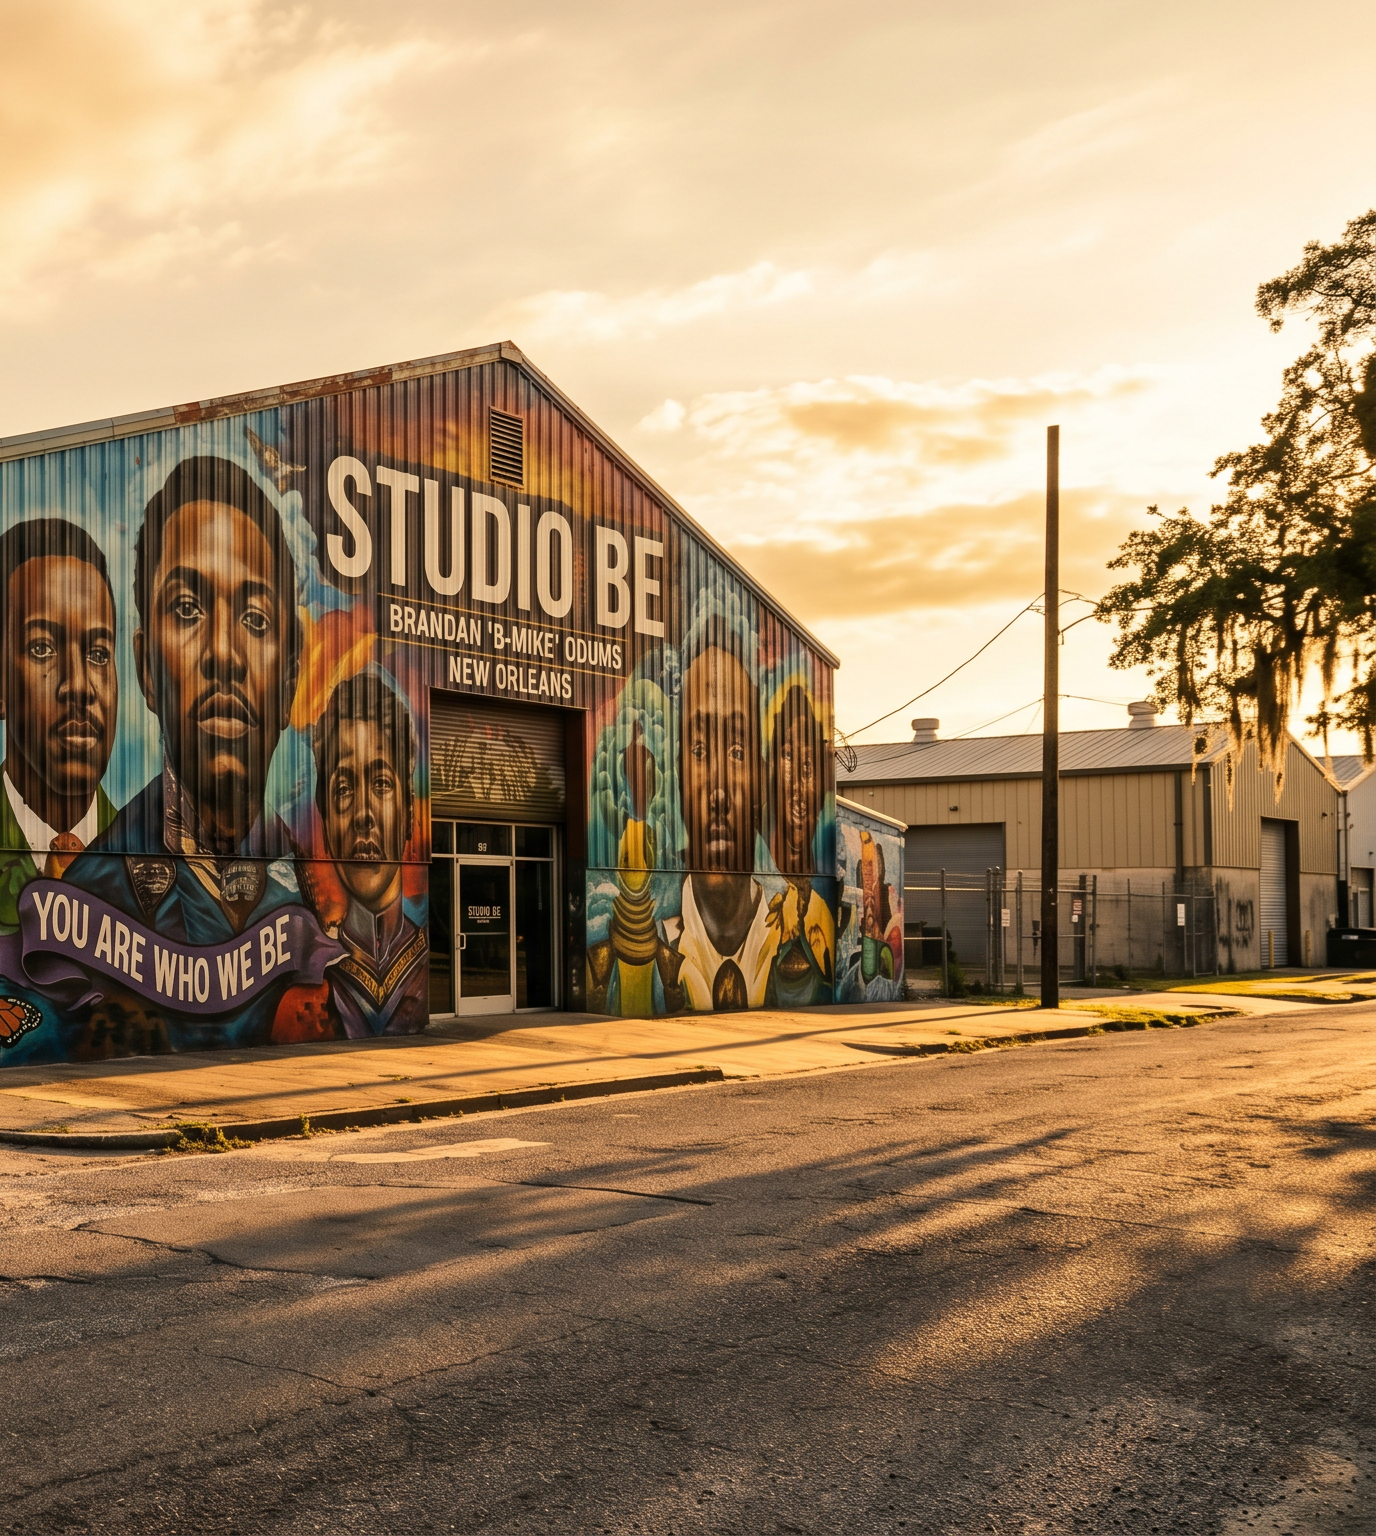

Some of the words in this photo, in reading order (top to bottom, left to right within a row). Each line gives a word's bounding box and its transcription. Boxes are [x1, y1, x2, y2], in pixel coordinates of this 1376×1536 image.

[326, 455, 573, 618] STUDIO
[596, 524, 665, 638] BE
[390, 603, 481, 646] BRANDAN
[565, 636, 622, 670] ODUMS
[449, 655, 490, 687] NEW
[495, 663, 572, 698] ORLEANS
[492, 906, 501, 916] BE
[32, 891, 89, 949] YOU
[94, 914, 146, 984] ARE
[154, 944, 210, 1003] WHO
[216, 940, 254, 1001] WE
[260, 914, 291, 976] BE
